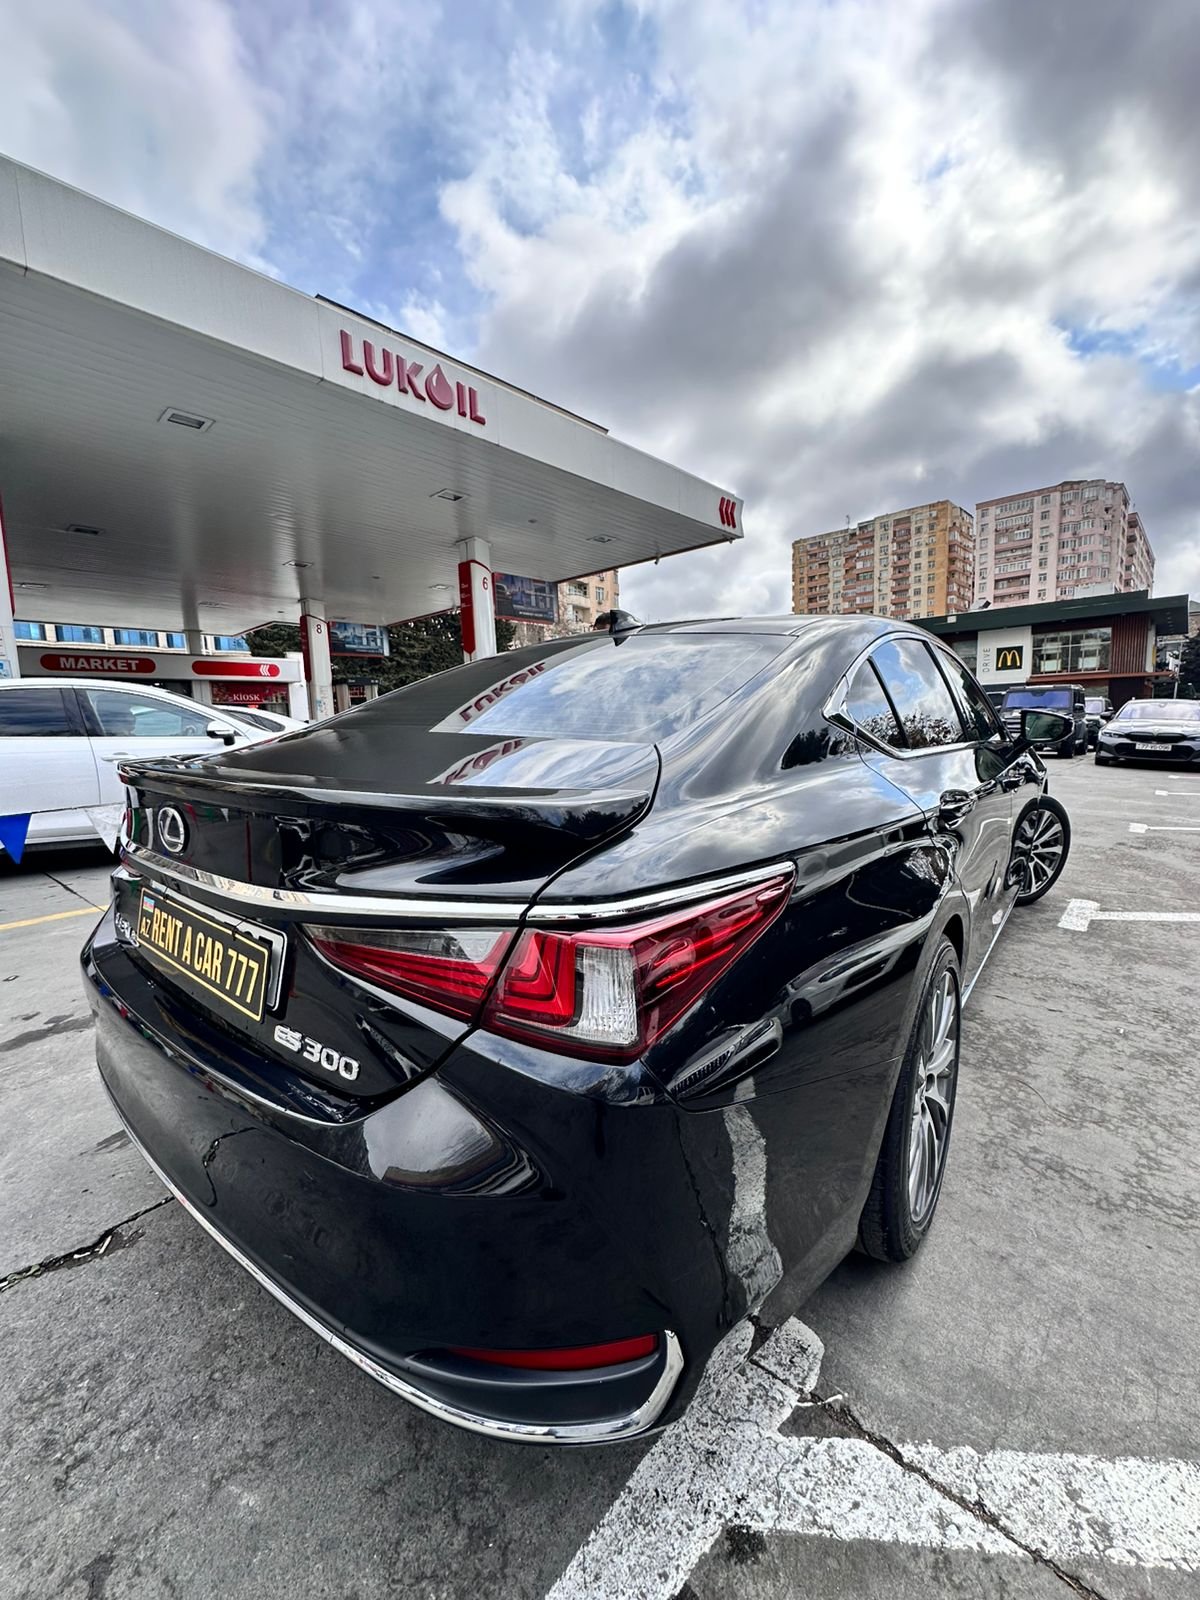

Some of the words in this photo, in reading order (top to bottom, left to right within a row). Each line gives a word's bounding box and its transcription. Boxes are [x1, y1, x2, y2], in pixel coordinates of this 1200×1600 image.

[340, 329, 486, 426] LUKOIL
[482, 577, 488, 590] 6
[316, 624, 322, 634] 8
[60, 657, 139, 671] MARKET
[982, 647, 991, 673] DRIVE
[140, 916, 151, 938] AZ
[152, 907, 183, 957] RENT
[182, 926, 192, 965] A
[194, 931, 224, 984] CAR
[225, 948, 259, 1003] 777
[274, 1025, 302, 1052] ES
[303, 1036, 360, 1080] 300
